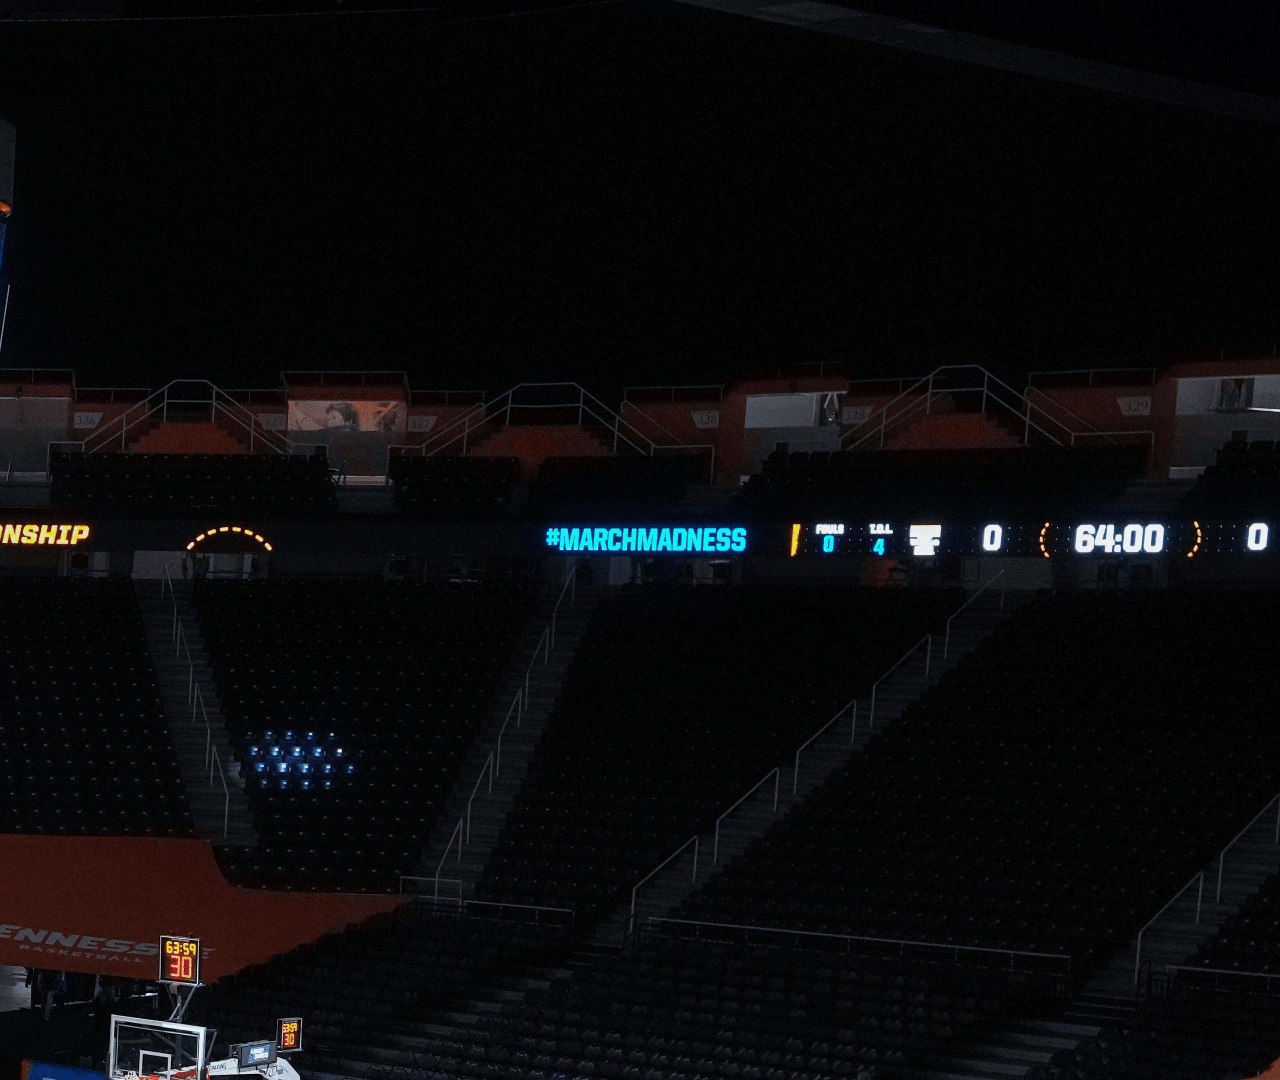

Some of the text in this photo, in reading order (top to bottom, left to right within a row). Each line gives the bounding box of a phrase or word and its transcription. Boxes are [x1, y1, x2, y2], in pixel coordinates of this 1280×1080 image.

[545, 527, 747, 551] #MARCHMADNESS
[822, 534, 835, 553] 0
[873, 538, 886, 555] 4
[982, 524, 1003, 552] 0
[1074, 523, 1165, 554] 64:00
[1246, 522, 1269, 551] 0
[18, 944, 142, 964] BASKETBALL
[165, 940, 197, 956] 63:59
[170, 955, 193, 979] 30
[284, 1033, 295, 1046] 30
